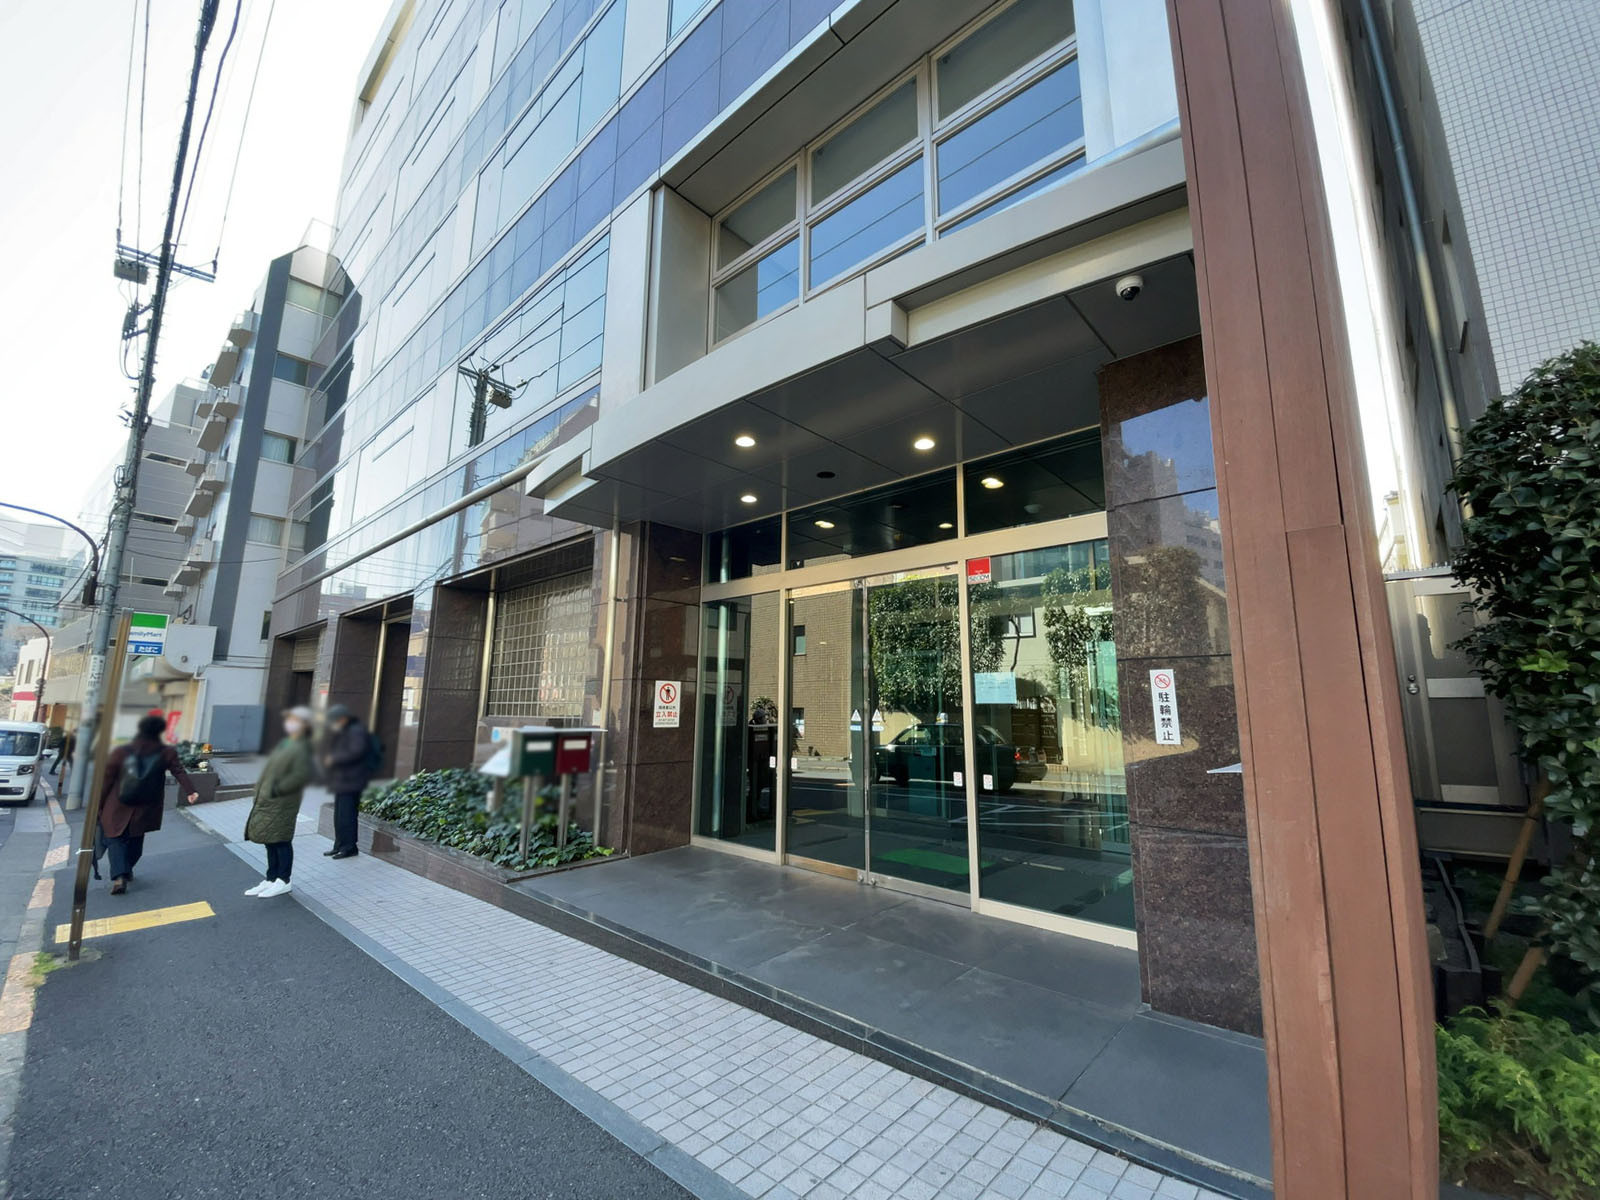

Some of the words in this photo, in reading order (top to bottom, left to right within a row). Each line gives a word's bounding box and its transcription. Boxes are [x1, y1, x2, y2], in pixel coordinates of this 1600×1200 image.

[138, 646, 159, 654] たばこ
[1158, 692, 1174, 741] 駐輪禁止
